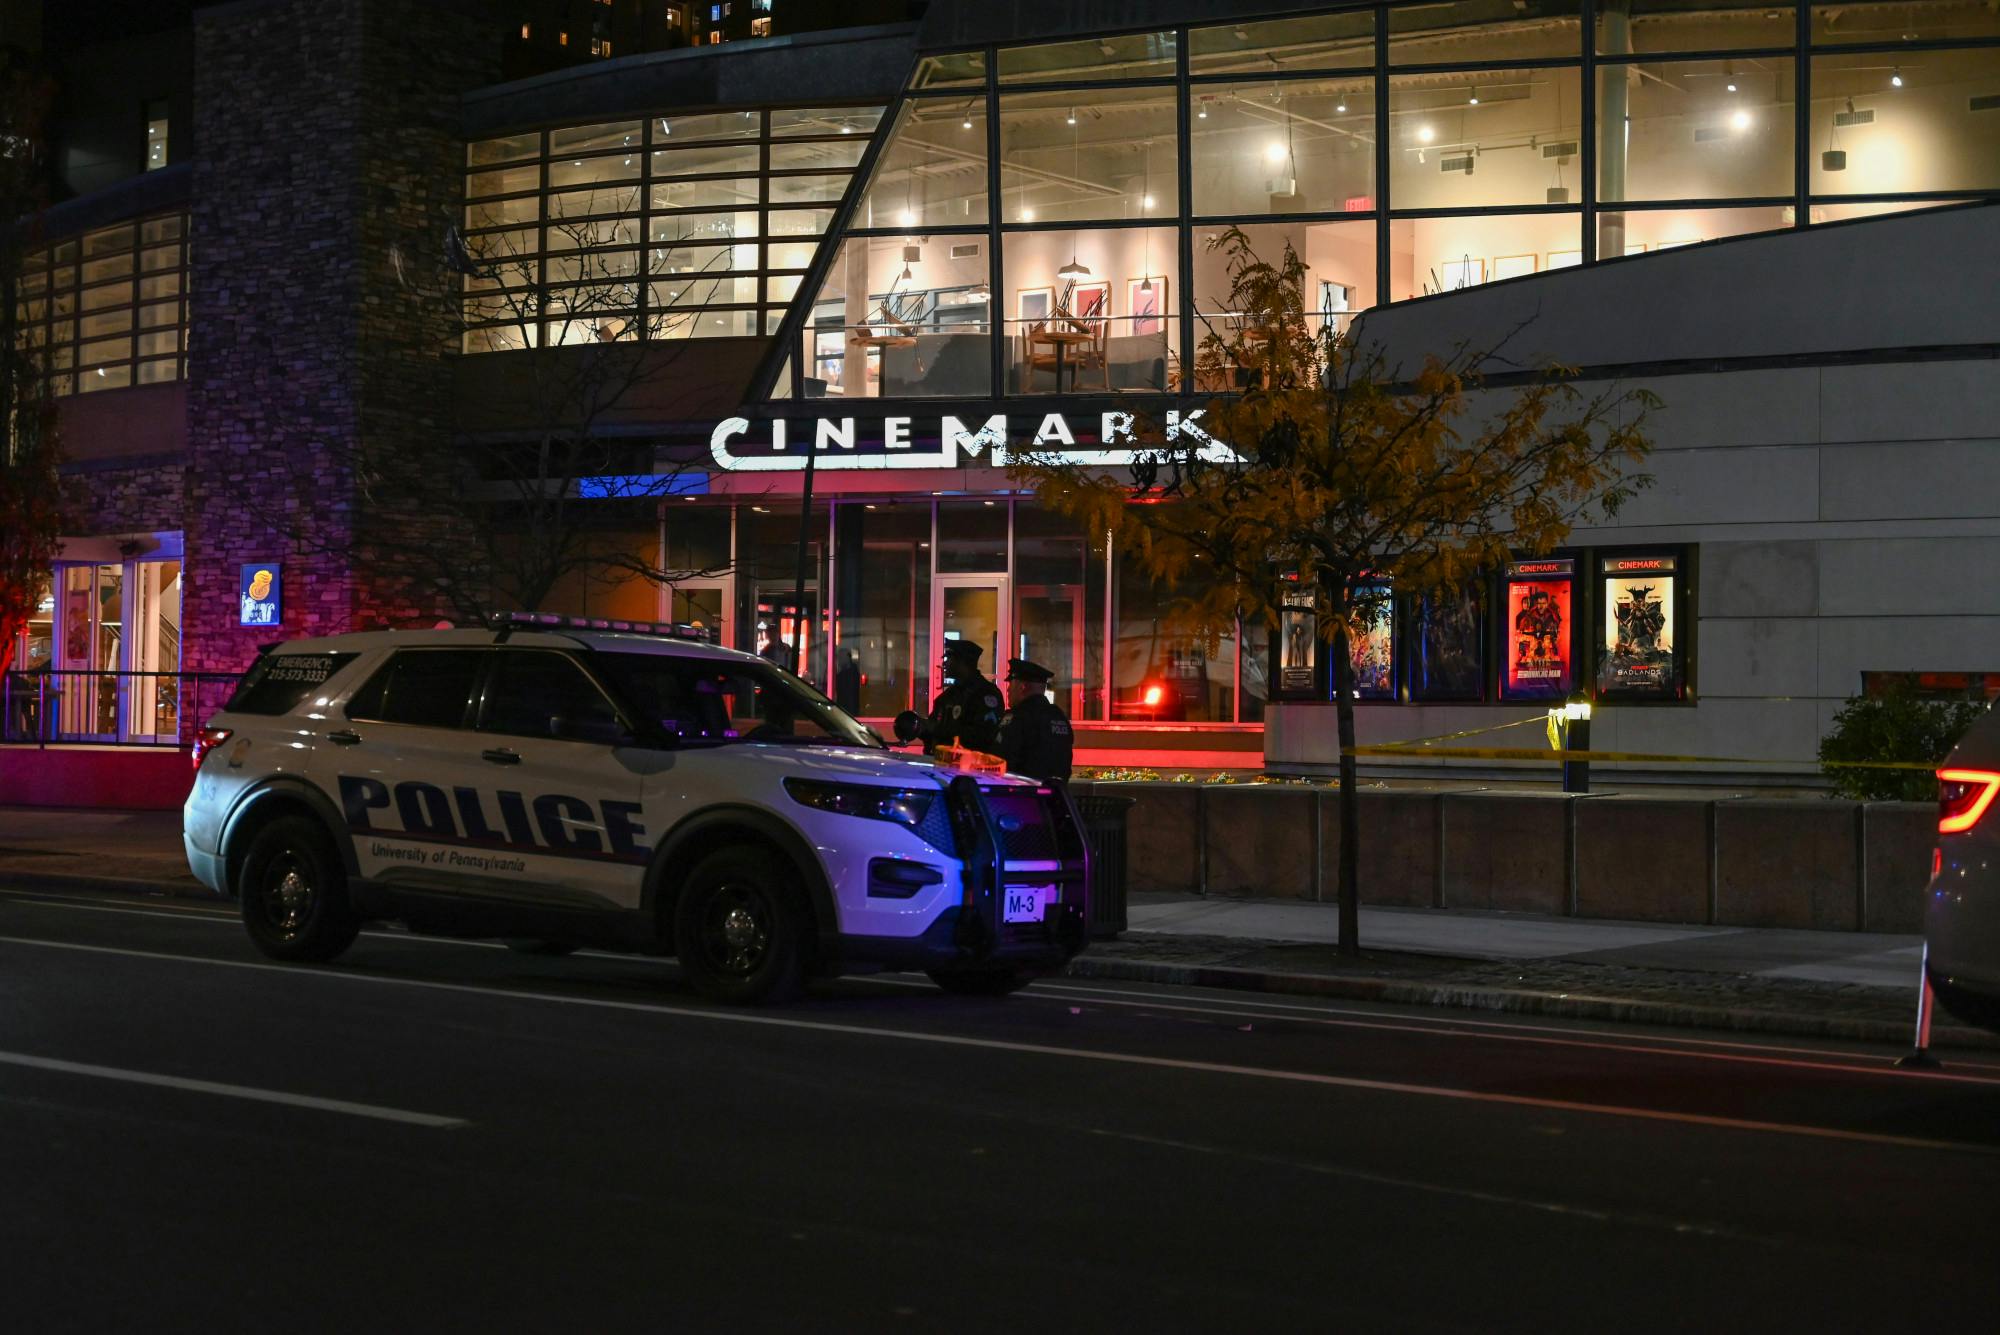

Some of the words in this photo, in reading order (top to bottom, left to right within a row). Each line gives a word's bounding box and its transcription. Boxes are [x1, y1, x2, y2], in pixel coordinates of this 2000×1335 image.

[709, 409, 1248, 470] CINEMARK
[1519, 563, 1558, 573] CINEMARK
[1618, 560, 1660, 569] CINEMARK
[277, 657, 332, 669] EMERGENCY:
[268, 669, 328, 682] 215-573-3333
[337, 775, 656, 854] POLICE
[372, 843, 427, 864] University
[432, 852, 445, 863] of
[449, 852, 526, 873] Pennsylvania
[1009, 895, 1035, 913] M-3
